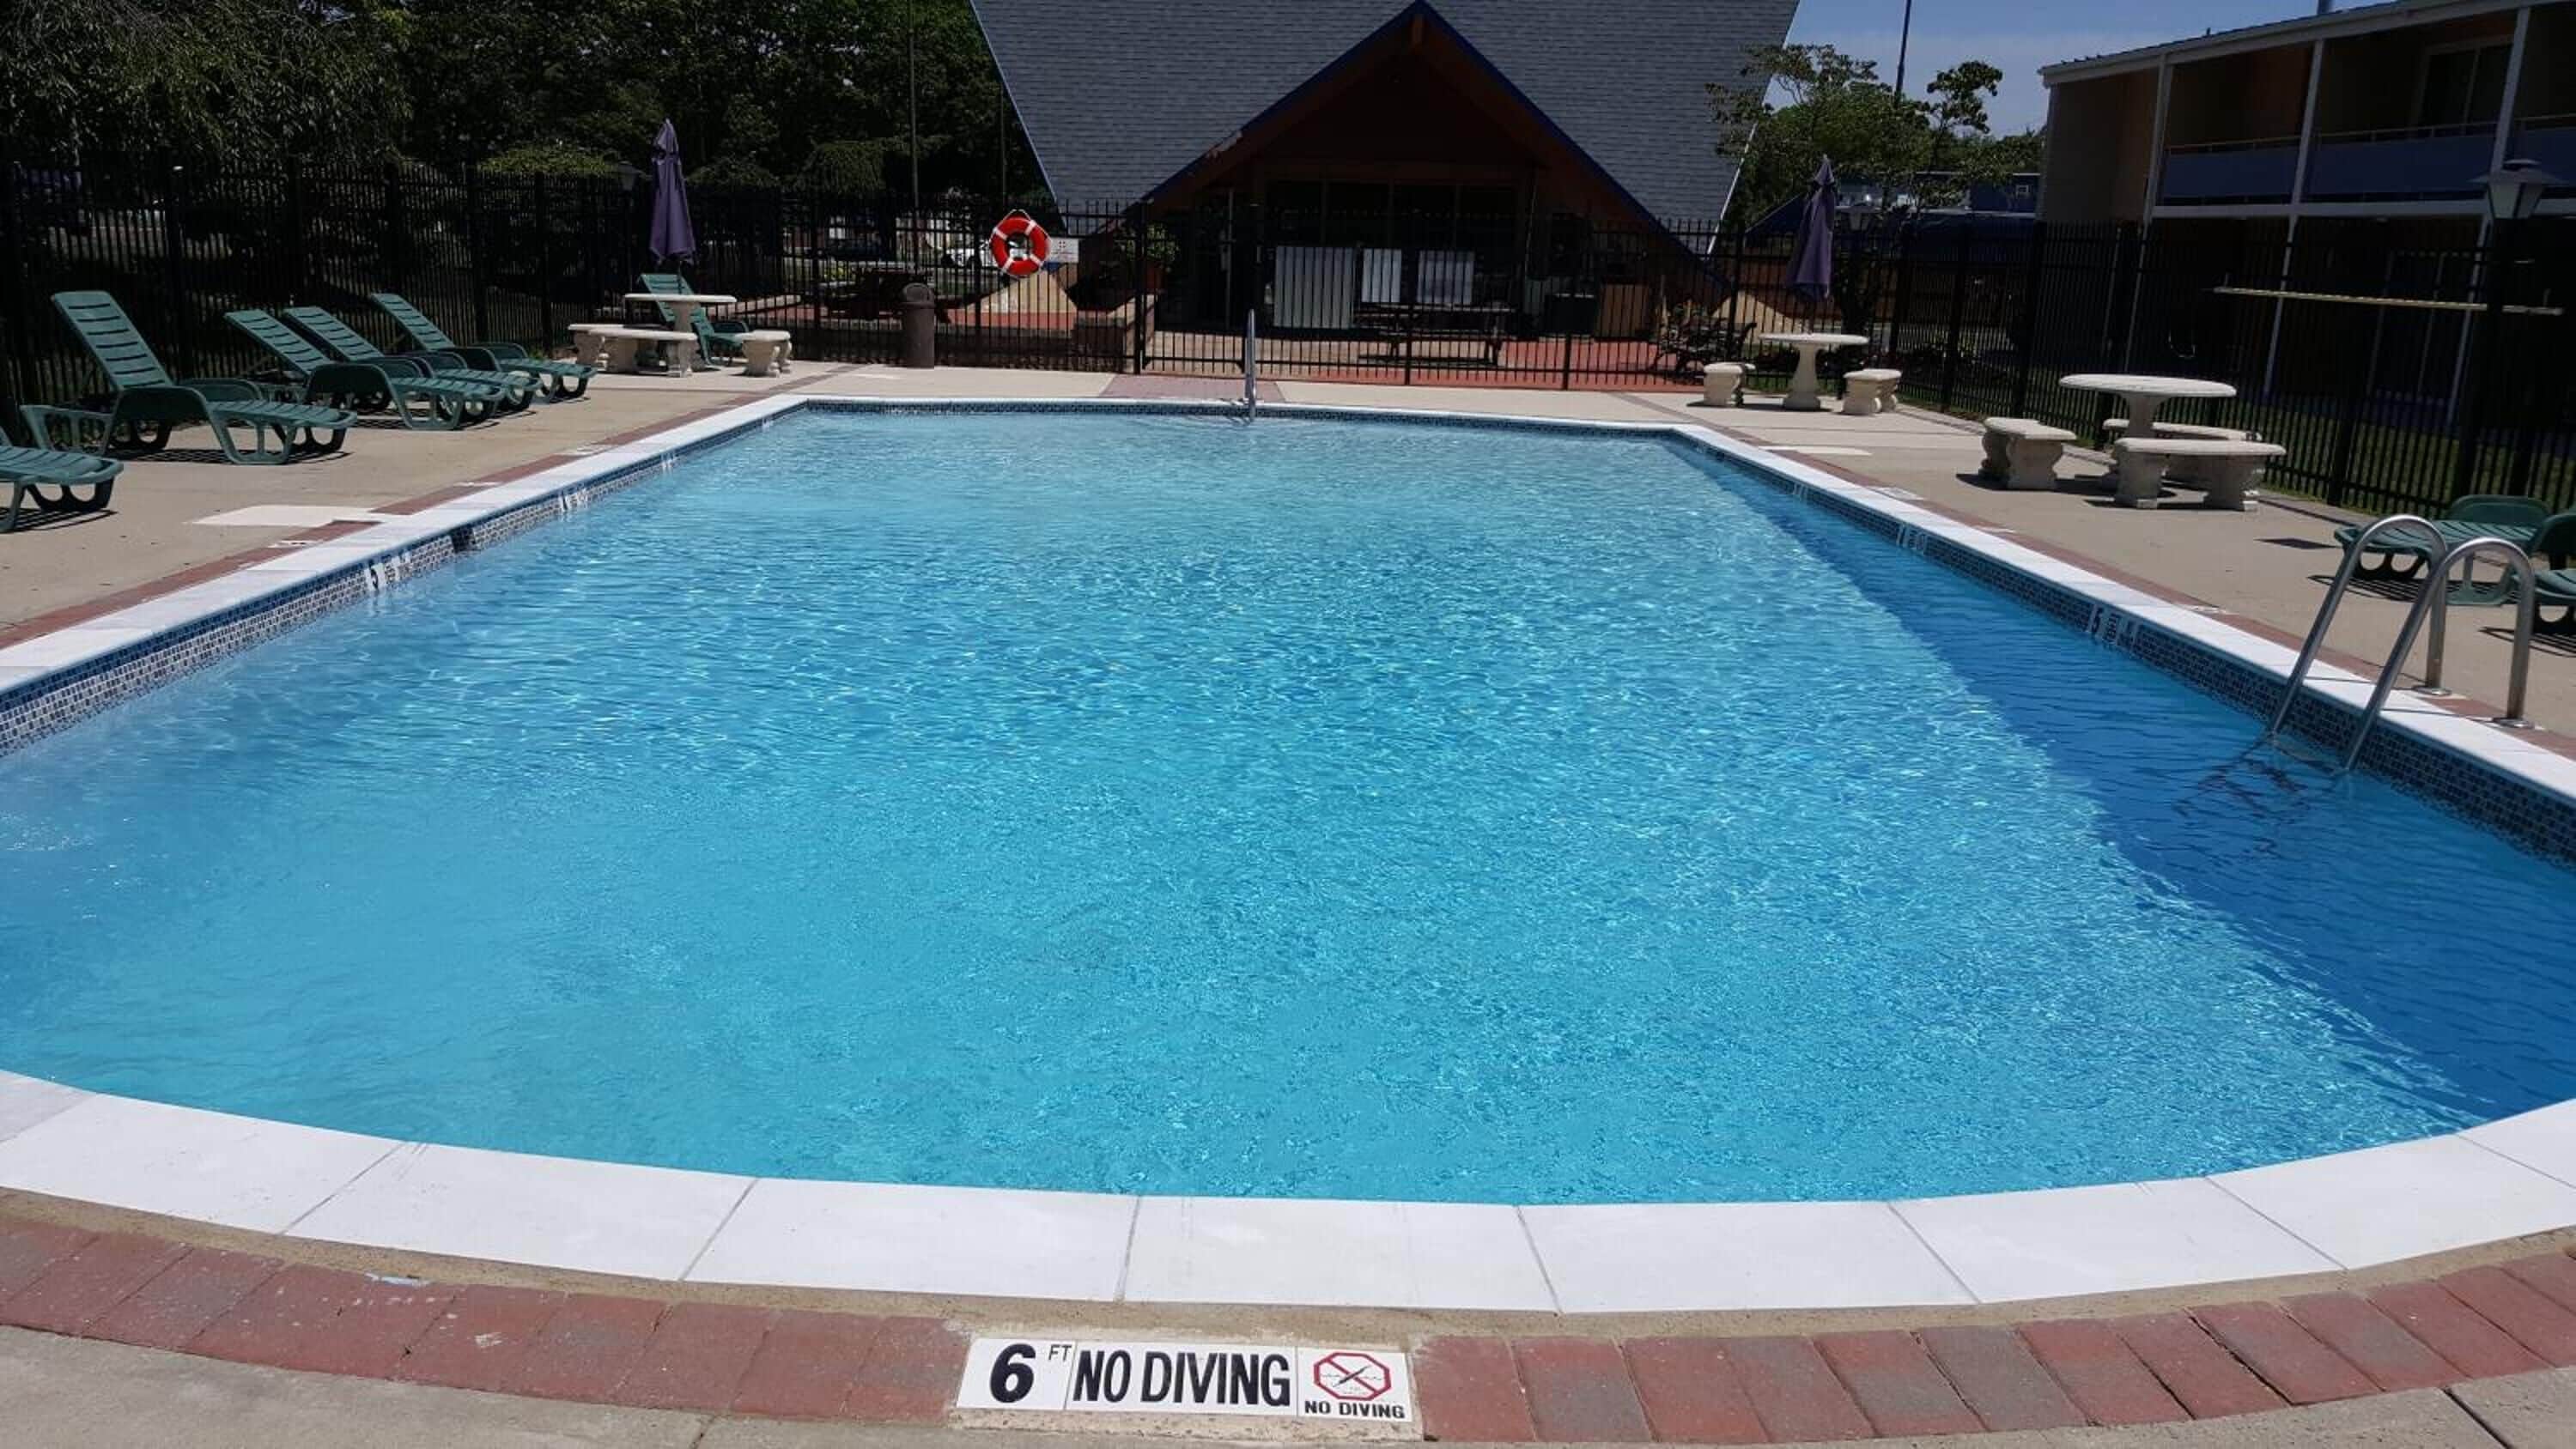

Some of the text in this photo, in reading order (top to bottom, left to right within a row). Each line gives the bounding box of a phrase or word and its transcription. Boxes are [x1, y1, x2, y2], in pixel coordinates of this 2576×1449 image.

[989, 1343, 1072, 1404] 6 FT
[1072, 1350, 1291, 1407] NO DIVING
[1304, 1400, 1405, 1419] NO DIVING
